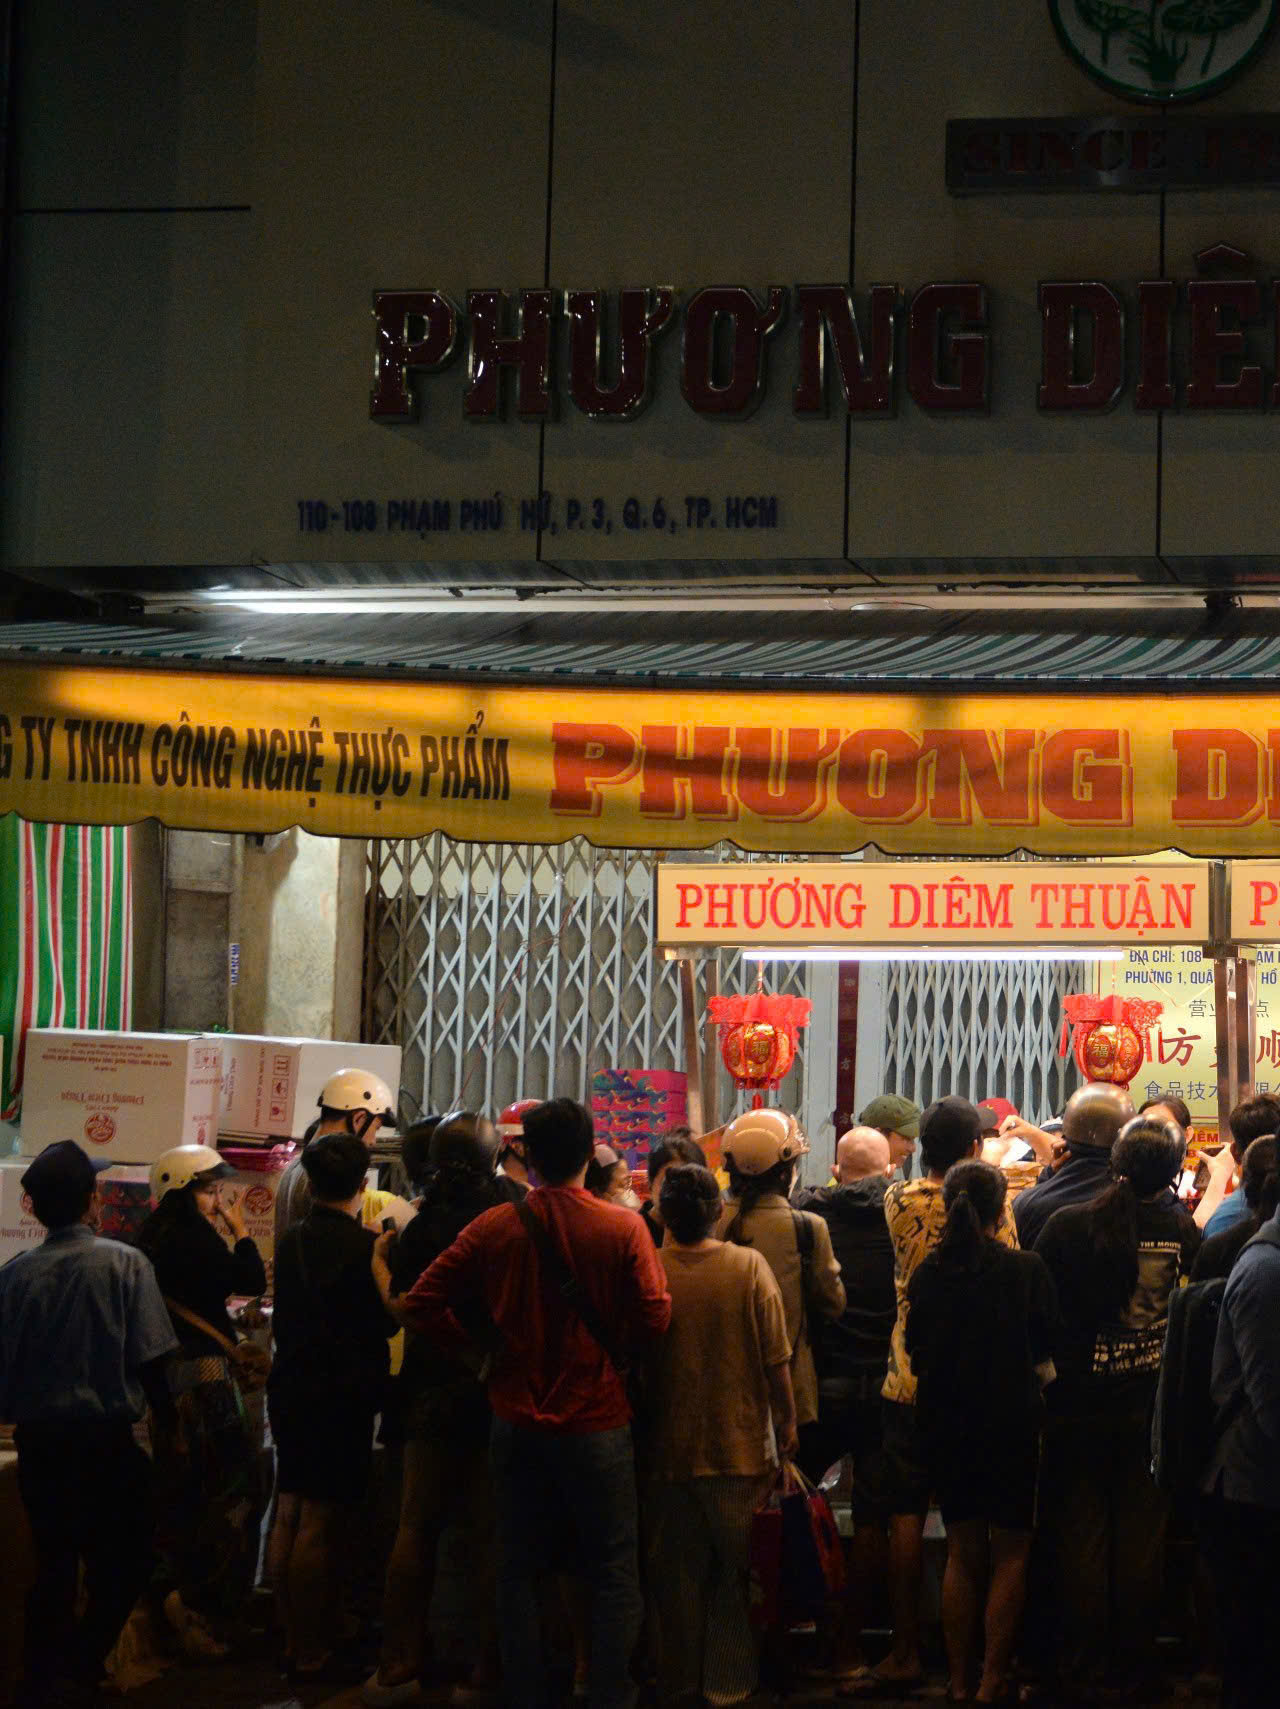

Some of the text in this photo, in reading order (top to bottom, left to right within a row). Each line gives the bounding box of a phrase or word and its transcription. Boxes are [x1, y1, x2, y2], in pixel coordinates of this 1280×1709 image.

[371, 284, 989, 424] PHƯƠNG
[459, 491, 504, 532] PHÚ
[686, 497, 718, 530] TP.
[725, 497, 778, 529] HCM
[21, 716, 56, 781] TY
[63, 719, 142, 785] TNHH
[151, 711, 236, 790] CÔNG
[242, 716, 325, 808] NGHỆ
[334, 727, 411, 811] THỰC
[419, 710, 511, 801] PHẨM
[549, 721, 1134, 828] PHƯƠNG
[675, 875, 1196, 937] PHƯƠNG DIÊM THUẬN
[1261, 968, 1277, 985] HỒ
